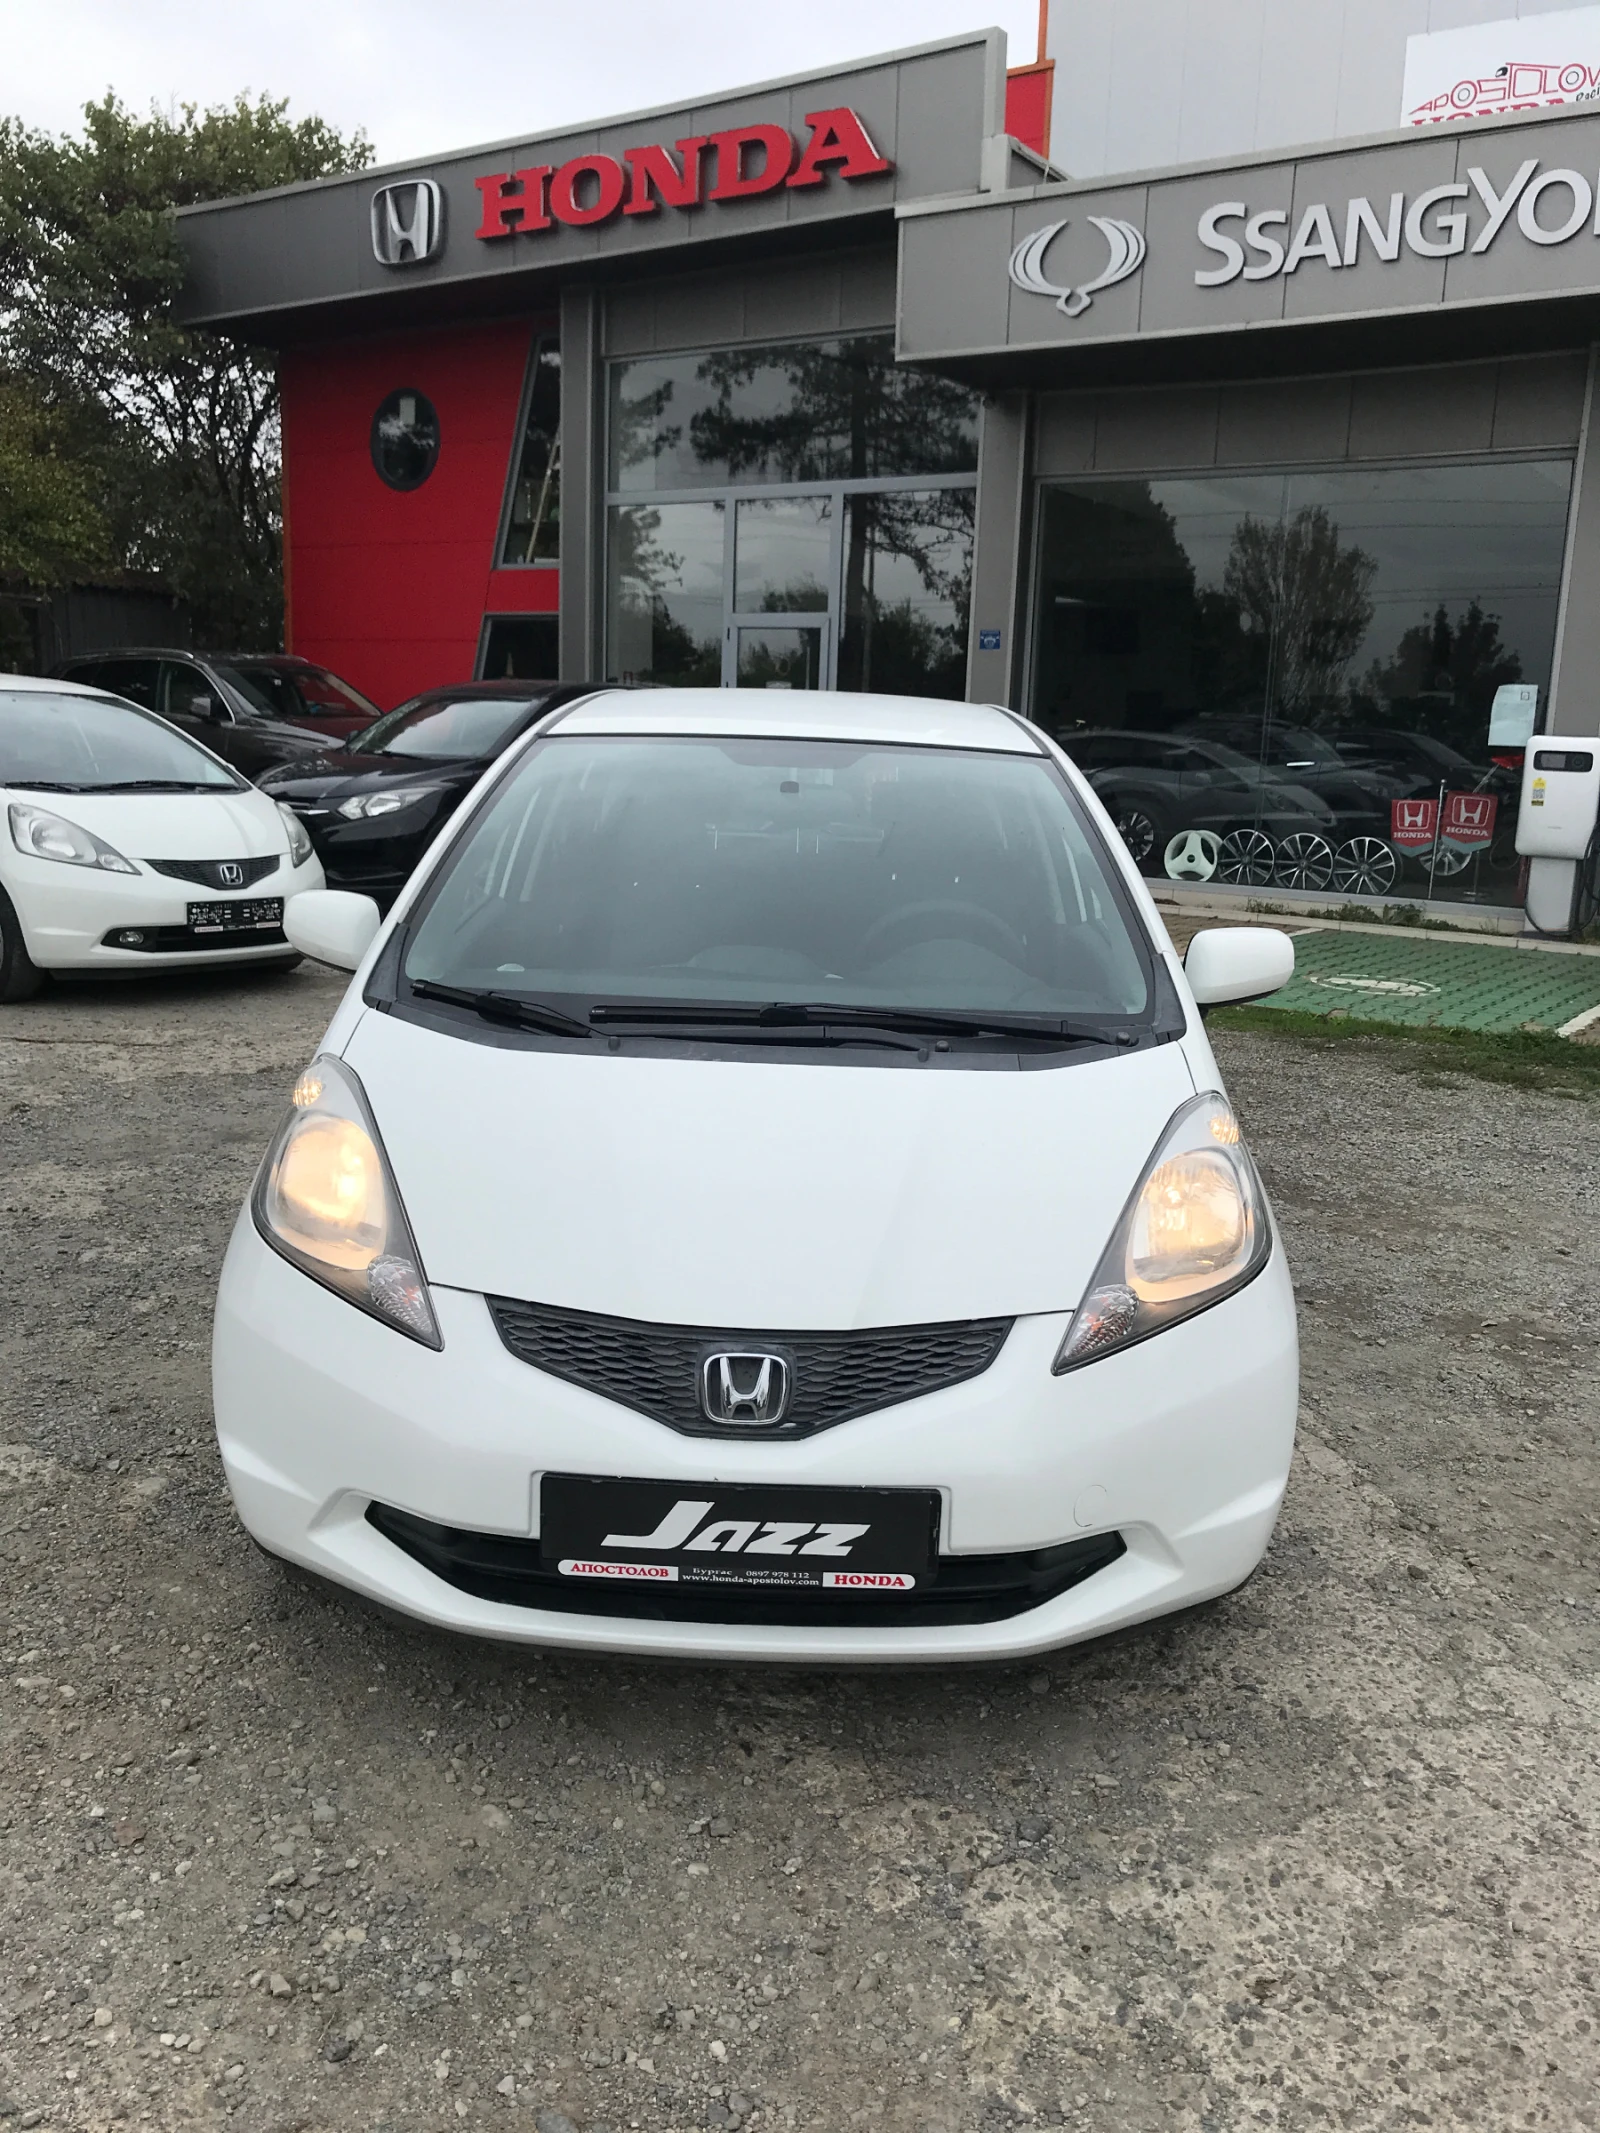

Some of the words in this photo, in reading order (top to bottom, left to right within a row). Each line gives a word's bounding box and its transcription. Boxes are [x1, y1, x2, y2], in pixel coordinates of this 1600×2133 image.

[475, 107, 893, 240] HONDA
[1194, 159, 1600, 286] SSANGYO
[1393, 831, 1433, 839] HONDA
[1446, 826, 1488, 837] HONDA
[682, 1574, 820, 1586] www.honda-apostolov.com
[834, 1574, 906, 1587] HONDA
